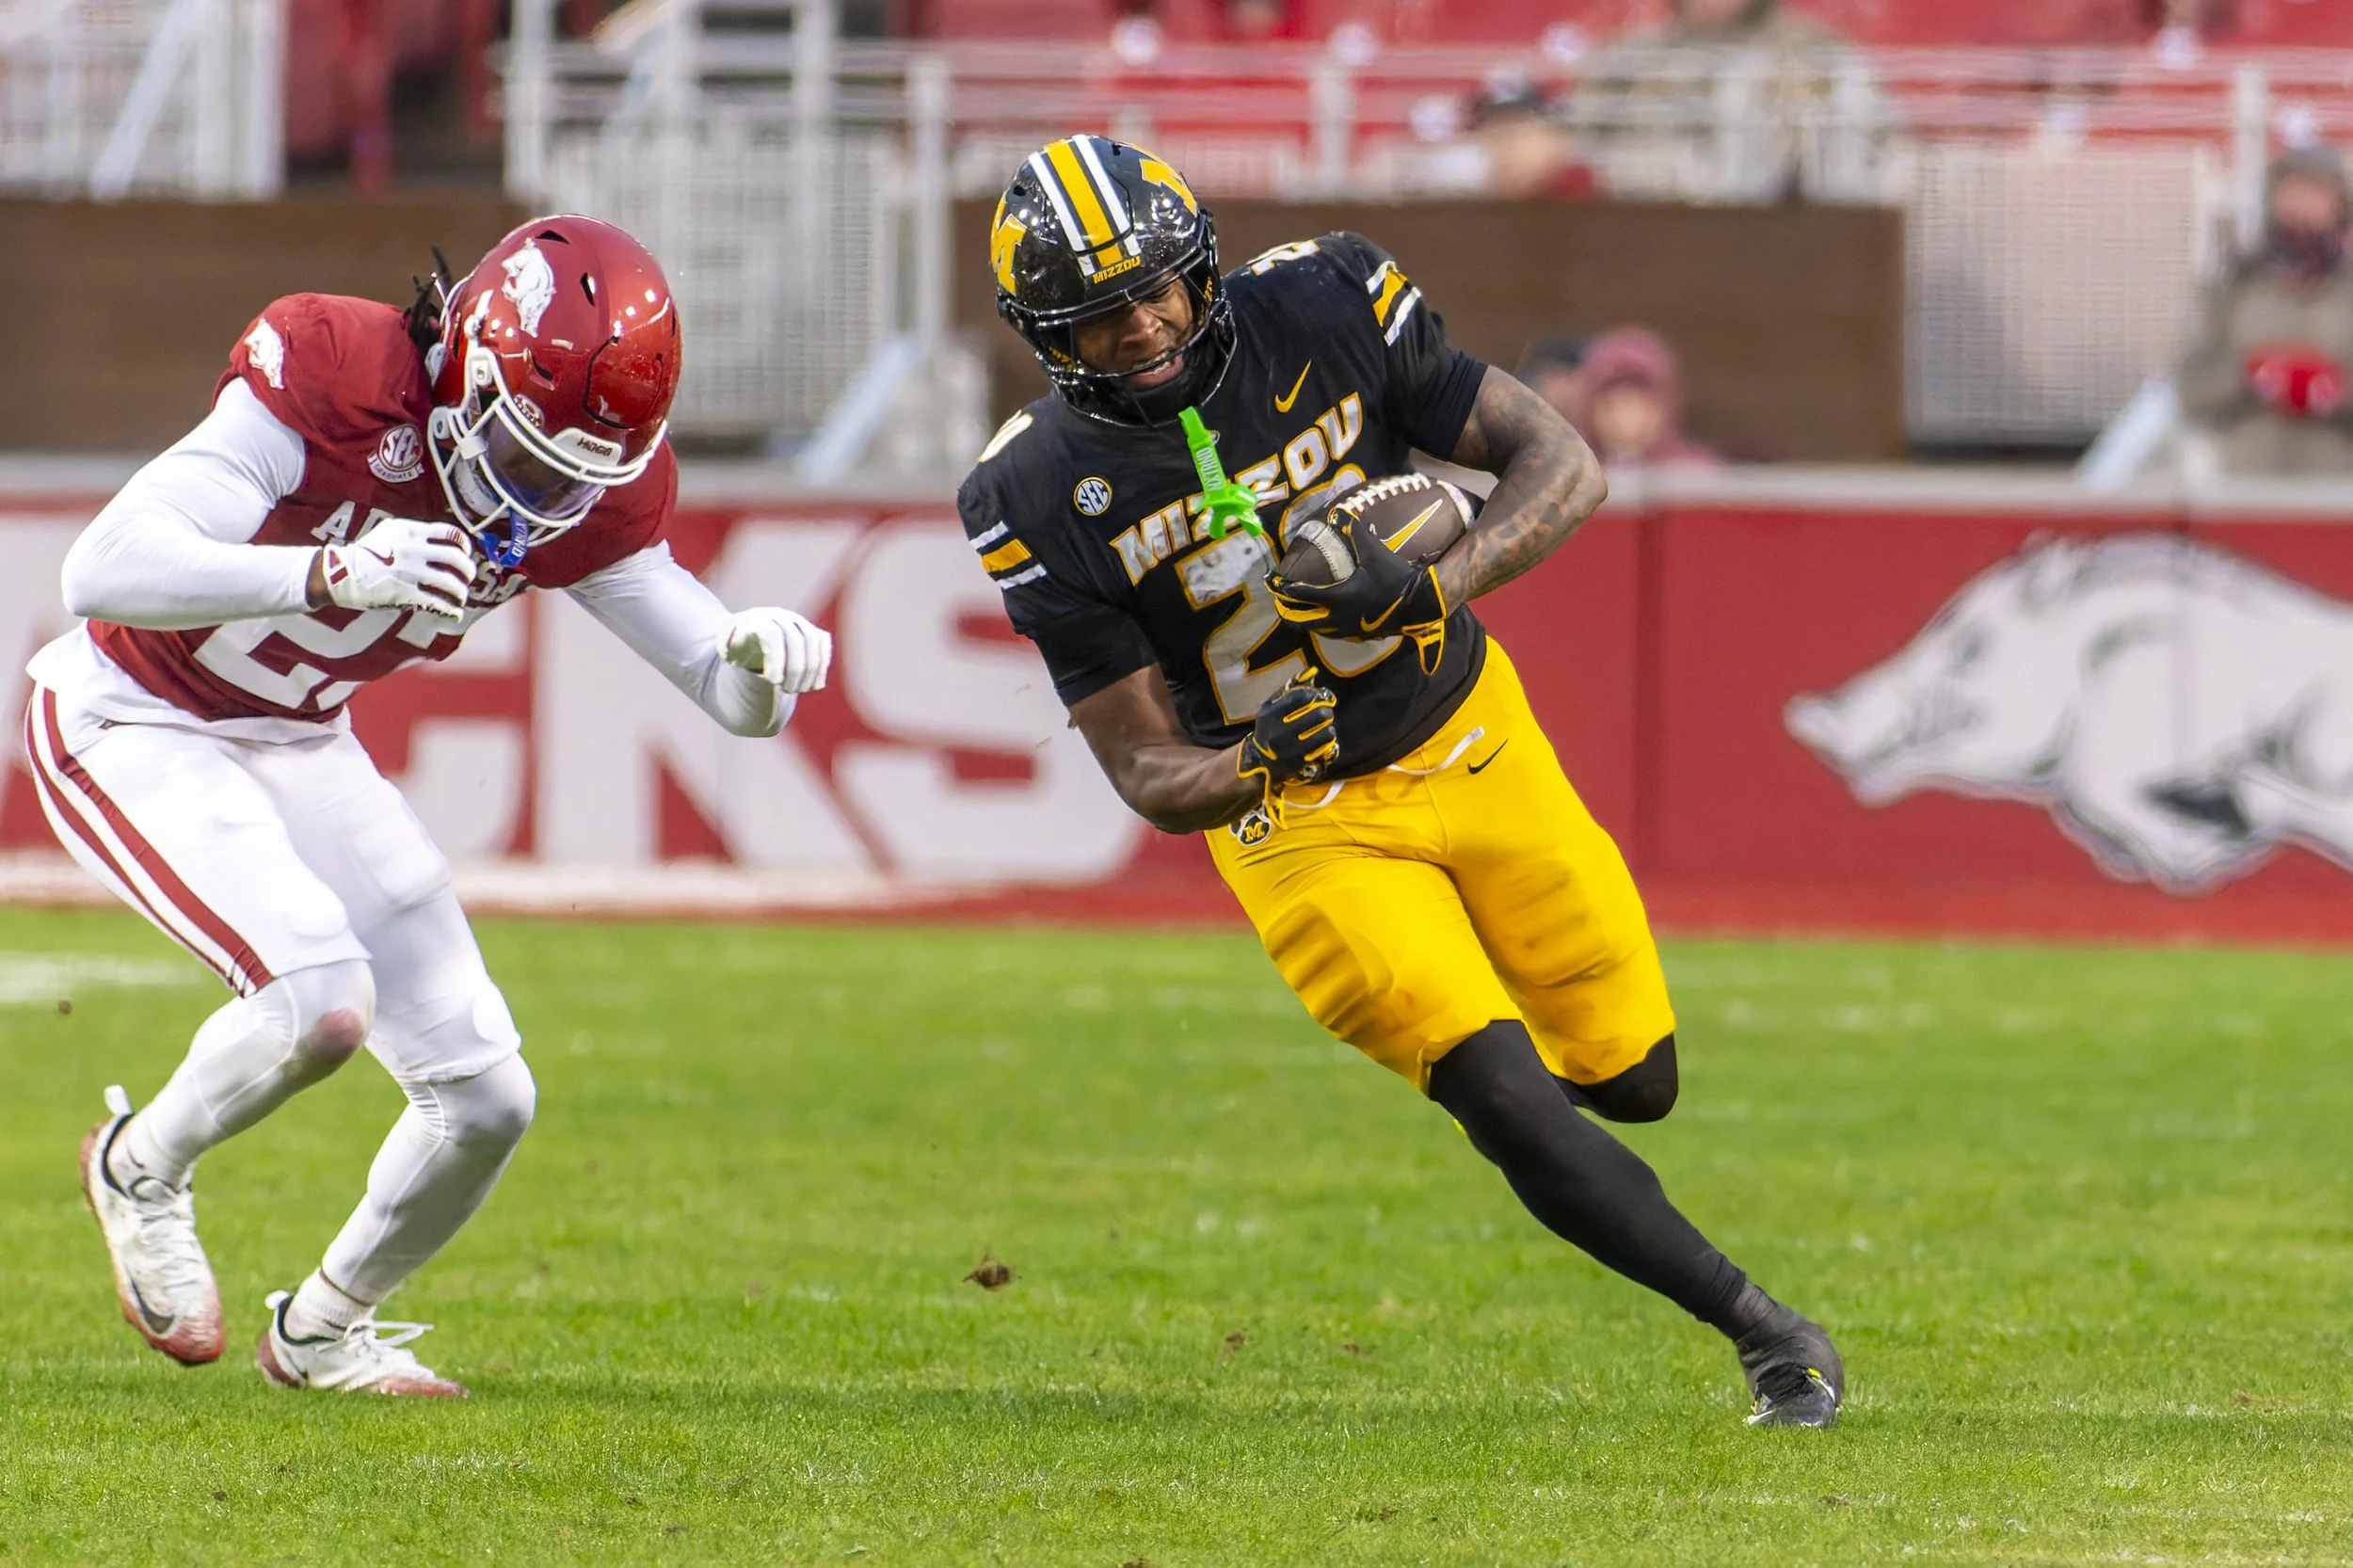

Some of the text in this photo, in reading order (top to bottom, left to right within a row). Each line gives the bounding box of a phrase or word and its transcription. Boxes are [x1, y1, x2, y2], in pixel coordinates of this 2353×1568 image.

[1092, 255, 1141, 284] MIZZOU
[382, 426, 422, 468] SEC
[1076, 478, 1111, 515] SEC
